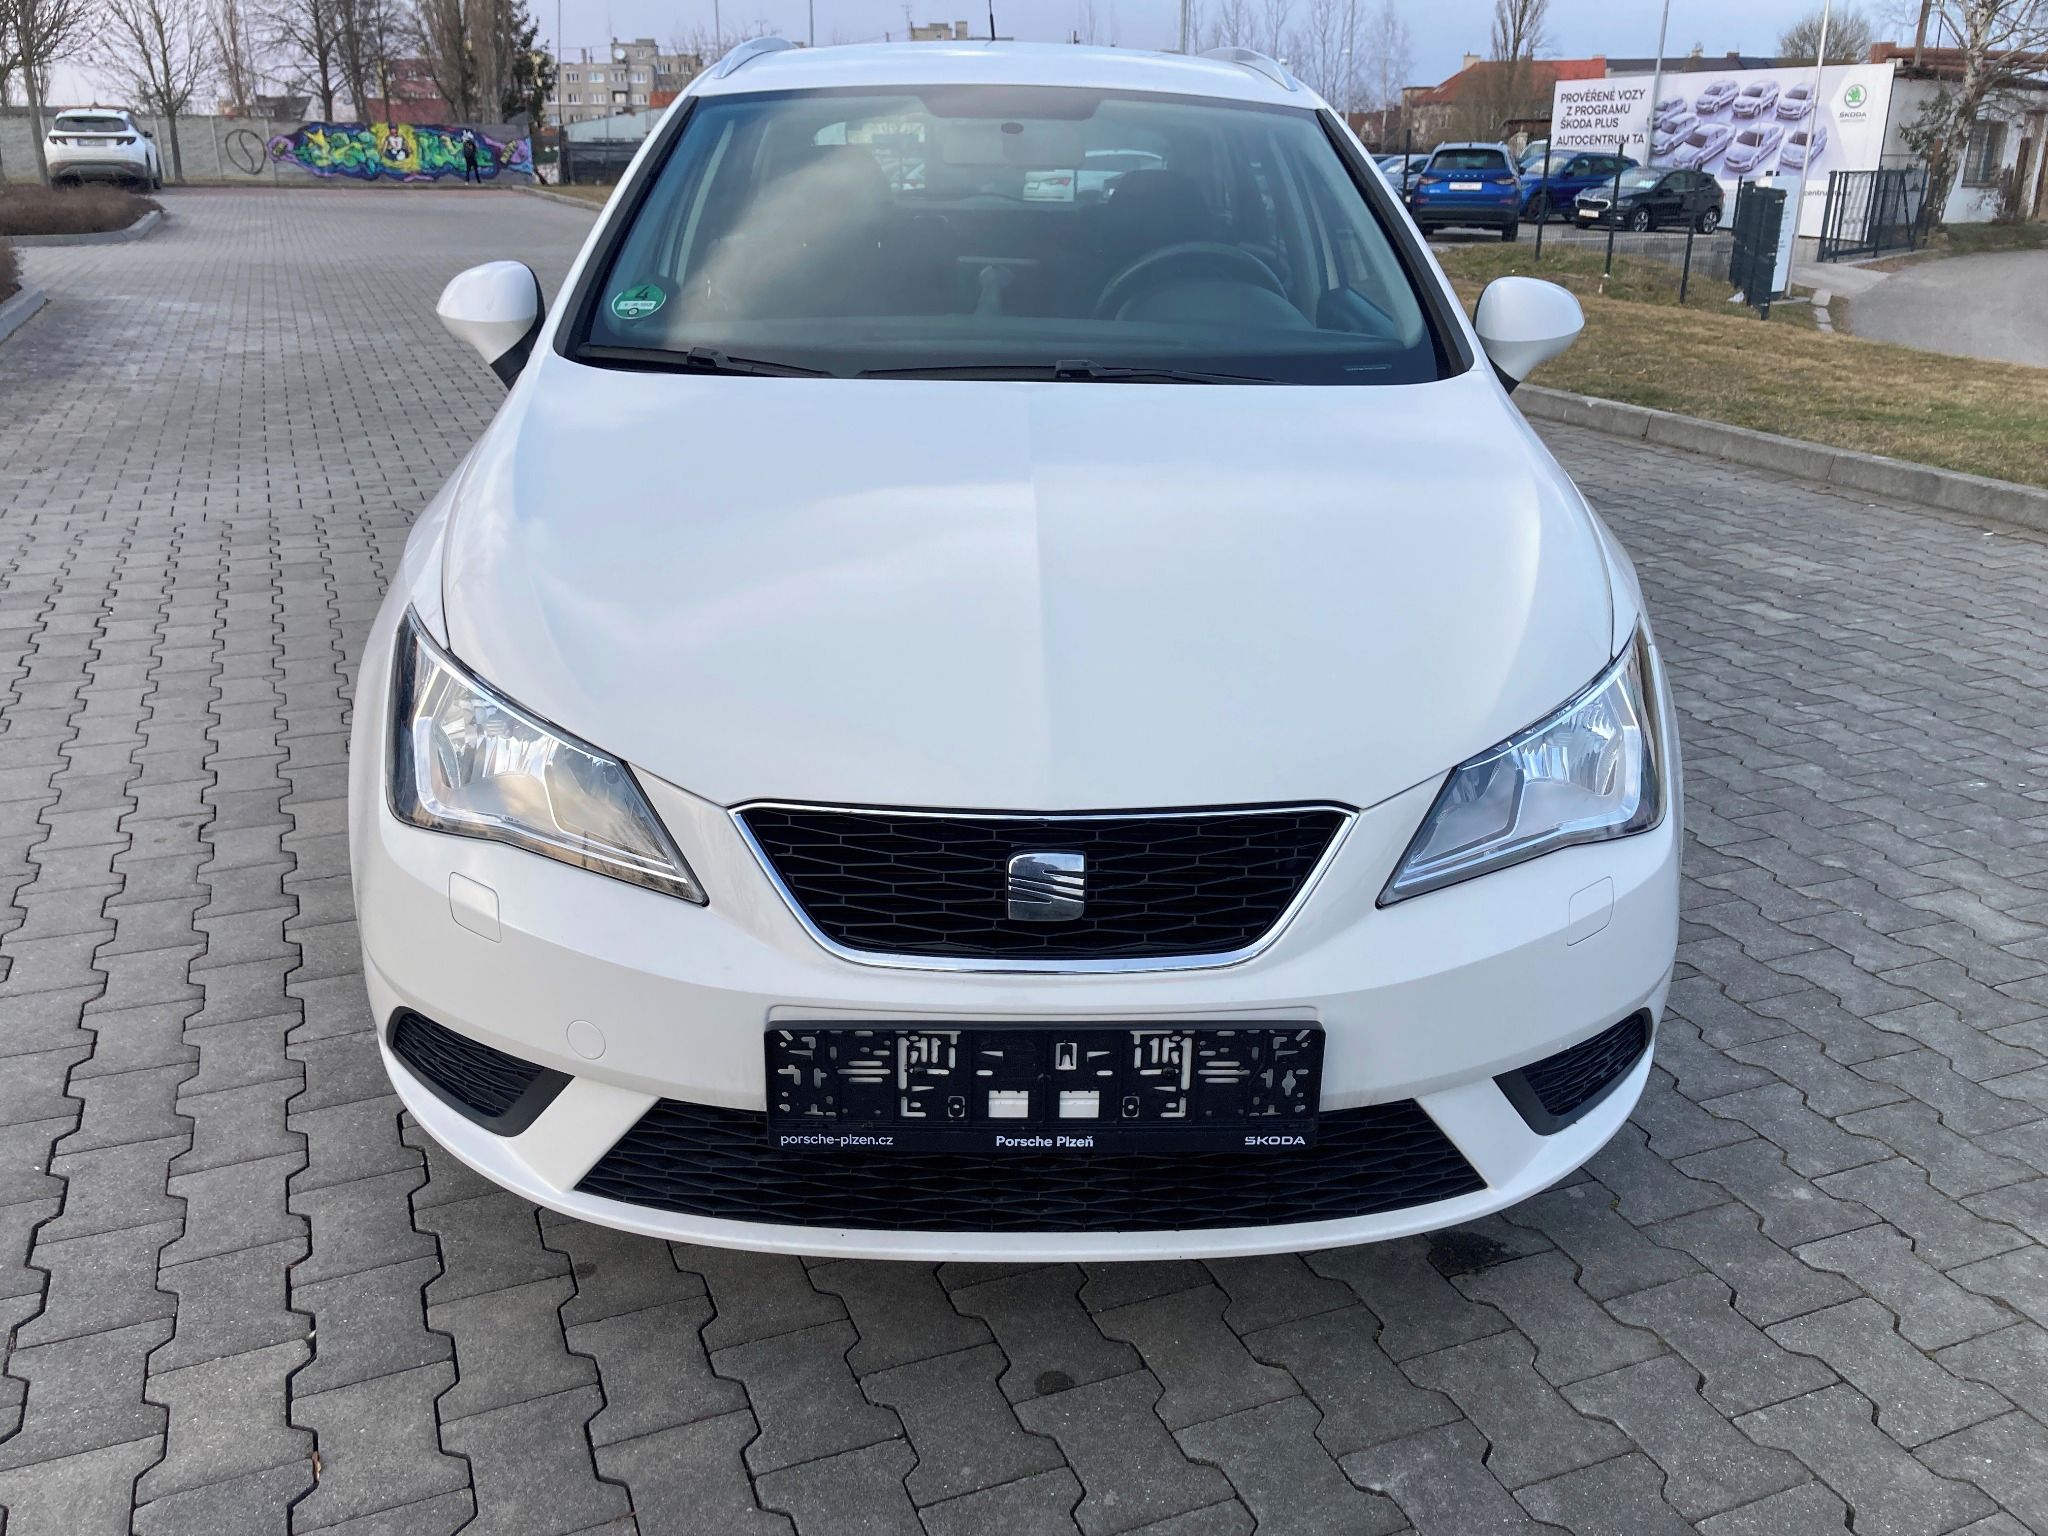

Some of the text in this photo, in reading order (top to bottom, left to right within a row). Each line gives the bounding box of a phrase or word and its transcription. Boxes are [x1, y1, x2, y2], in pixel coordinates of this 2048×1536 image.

[1560, 88, 1646, 103] PROVĚŘENÉ VOZY
[1566, 104, 1631, 116] Z PROGRAMU
[1560, 117, 1619, 129] ŠKODA PLUS
[1556, 134, 1645, 146] AUTOCENTRUM TA
[635, 286, 649, 300] 4
[780, 1134, 894, 1147] porsche-plzen.cz
[996, 1135, 1094, 1147] Porsche Plzeň
